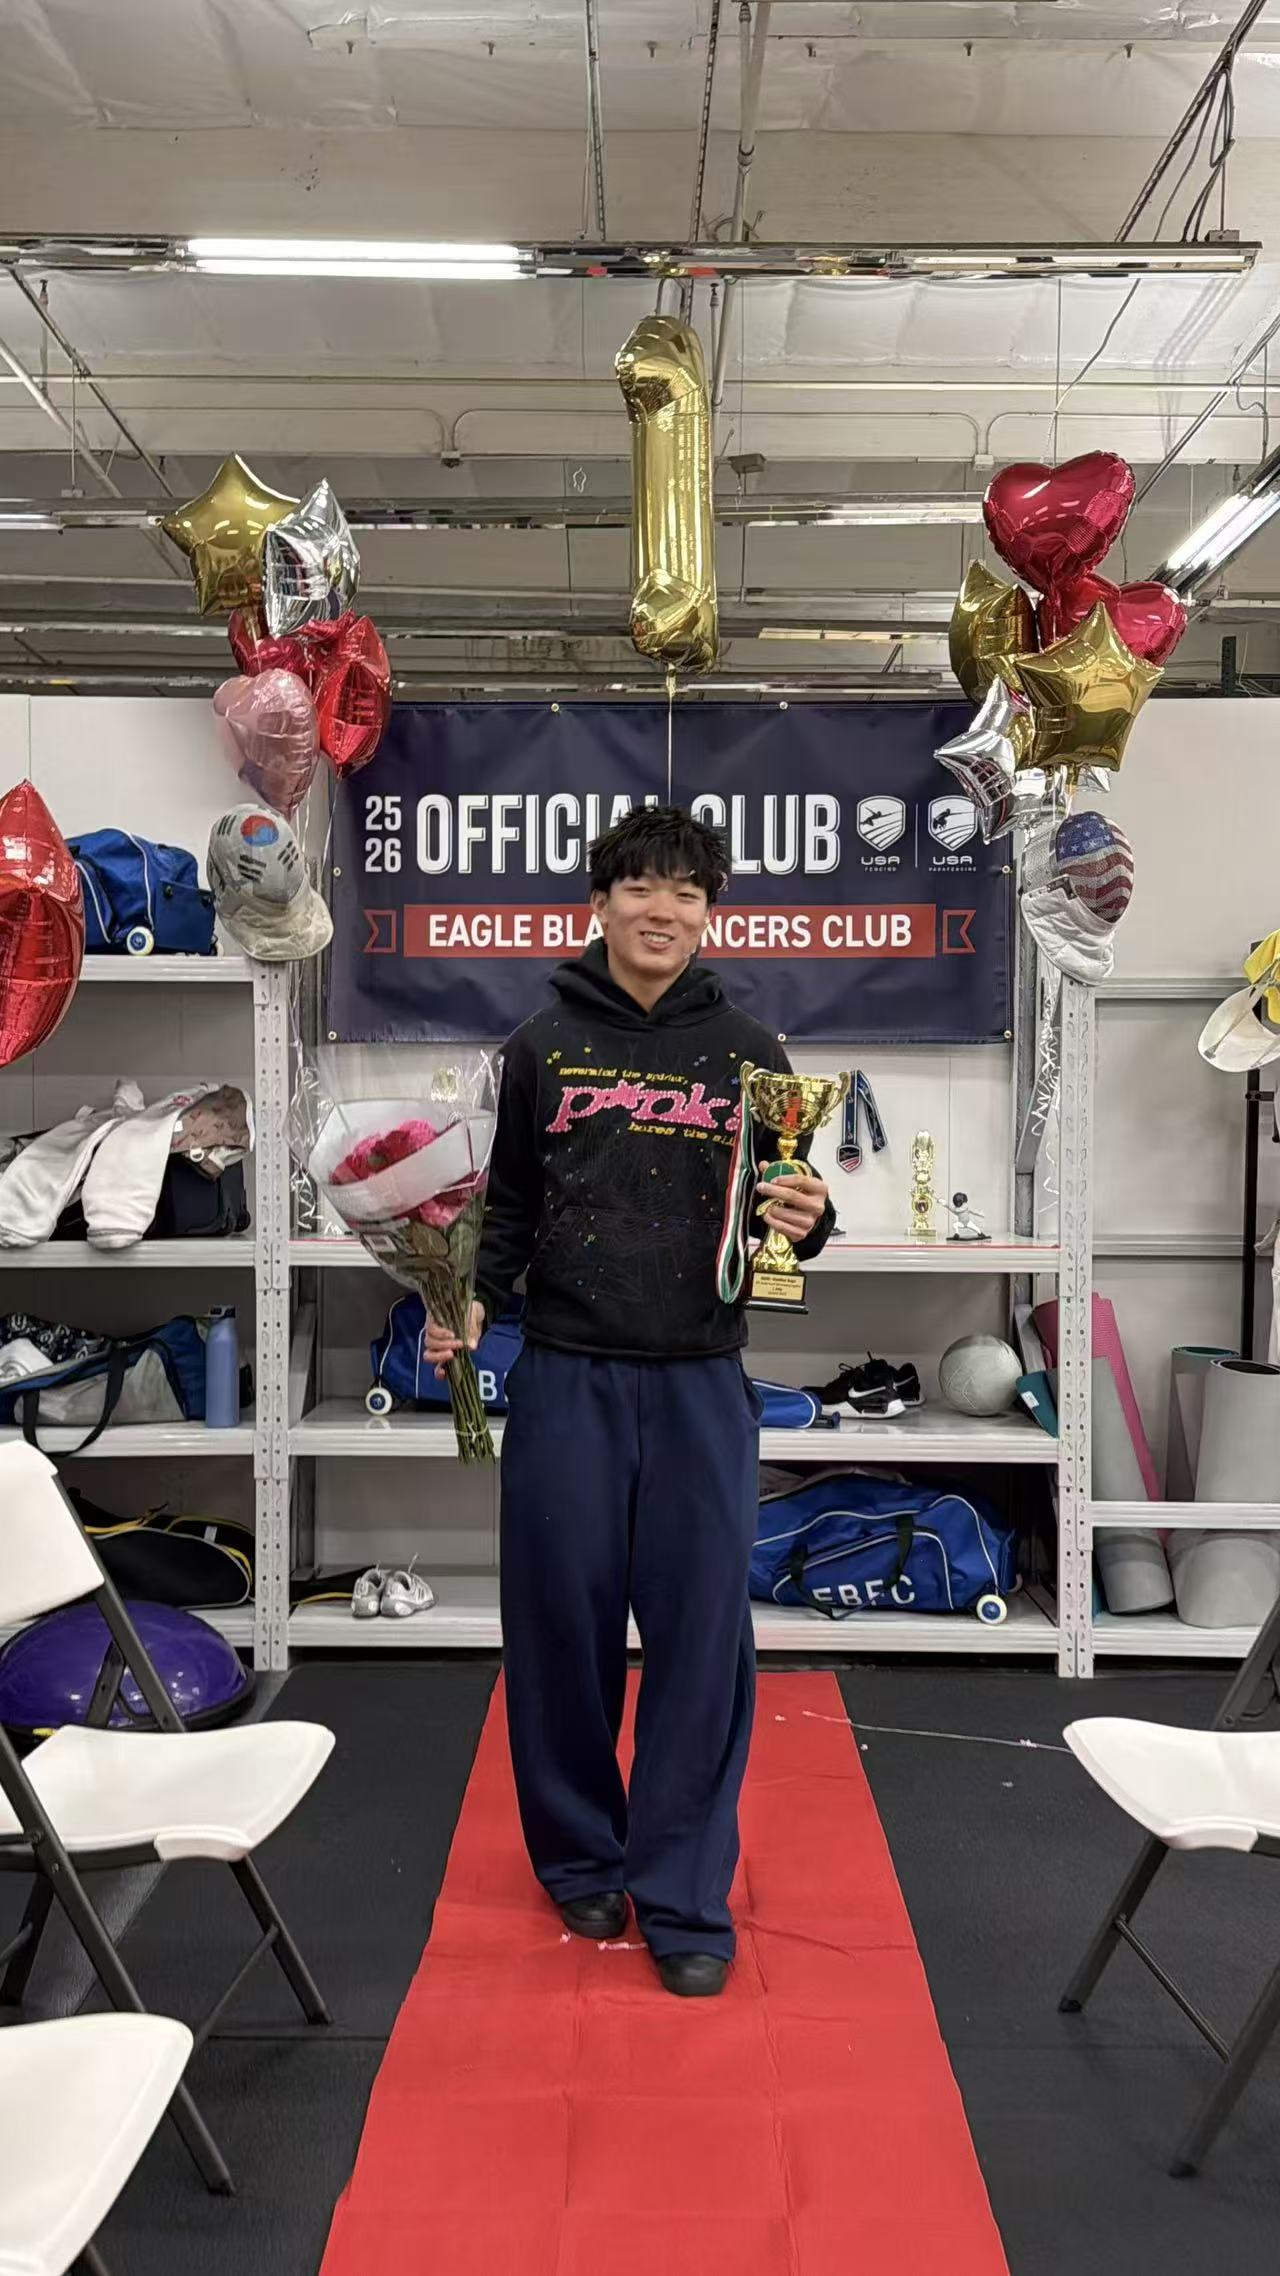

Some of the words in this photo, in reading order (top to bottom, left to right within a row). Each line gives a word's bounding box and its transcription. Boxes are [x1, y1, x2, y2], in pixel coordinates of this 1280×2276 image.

[365, 795, 402, 831] 25
[416, 793, 659, 875] OFFICI
[365, 837, 402, 873] 26
[860, 855, 901, 865] USA
[932, 855, 973, 865] USA
[429, 914, 533, 948] EAGLE
[542, 914, 606, 948] BLA
[700, 914, 812, 948] NCERS
[822, 914, 912, 948] CLUB
[811, 1573, 916, 1606] EBFC
